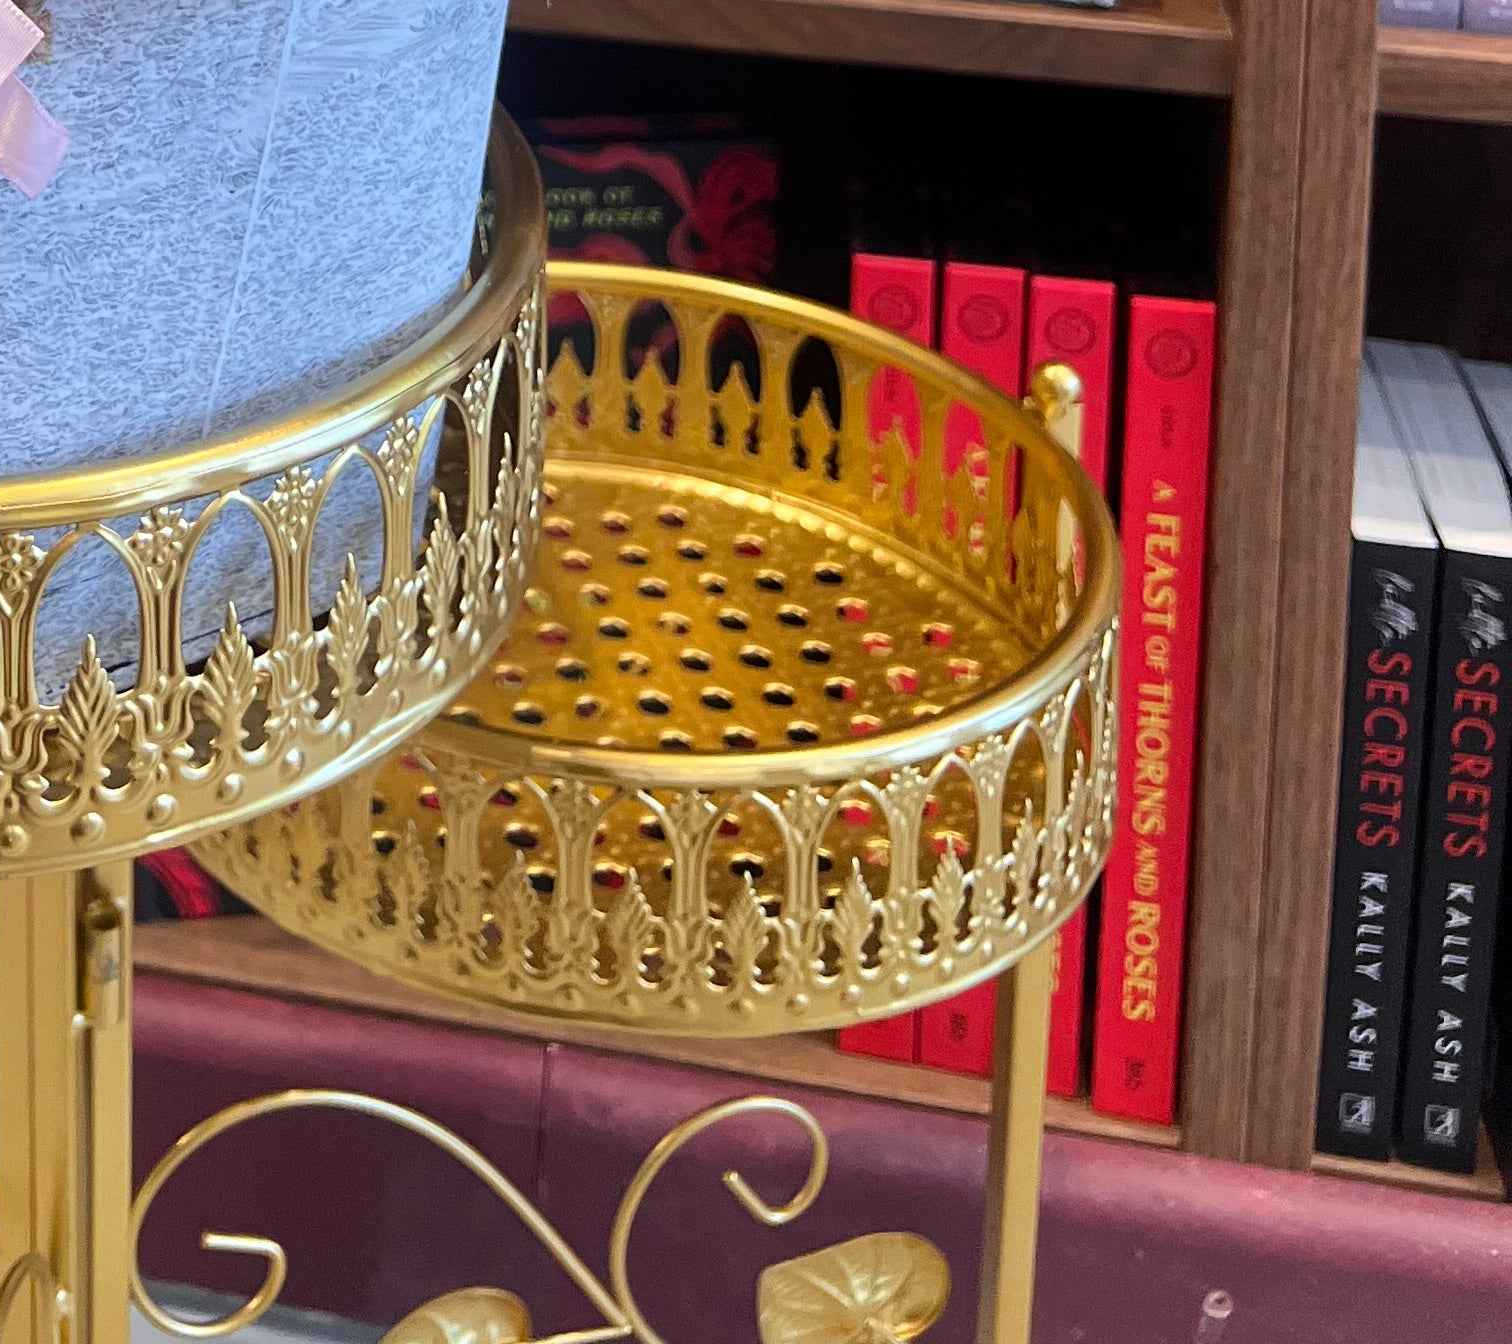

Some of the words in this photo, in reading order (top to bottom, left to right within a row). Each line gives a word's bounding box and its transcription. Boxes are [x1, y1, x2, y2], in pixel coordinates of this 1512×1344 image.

[1152, 479, 1178, 503] A
[1142, 512, 1181, 632] FEAST
[1131, 682, 1174, 836] THORNS
[1356, 648, 1413, 849] SECRETS
[1443, 658, 1501, 858] SECRETS
[1133, 839, 1159, 897] AND
[1121, 900, 1162, 1023] ROSES
[1354, 871, 1389, 983] KALLY
[1441, 882, 1476, 994] KALLY
[1346, 997, 1378, 1073] ASH
[1432, 1009, 1464, 1084] ASH
